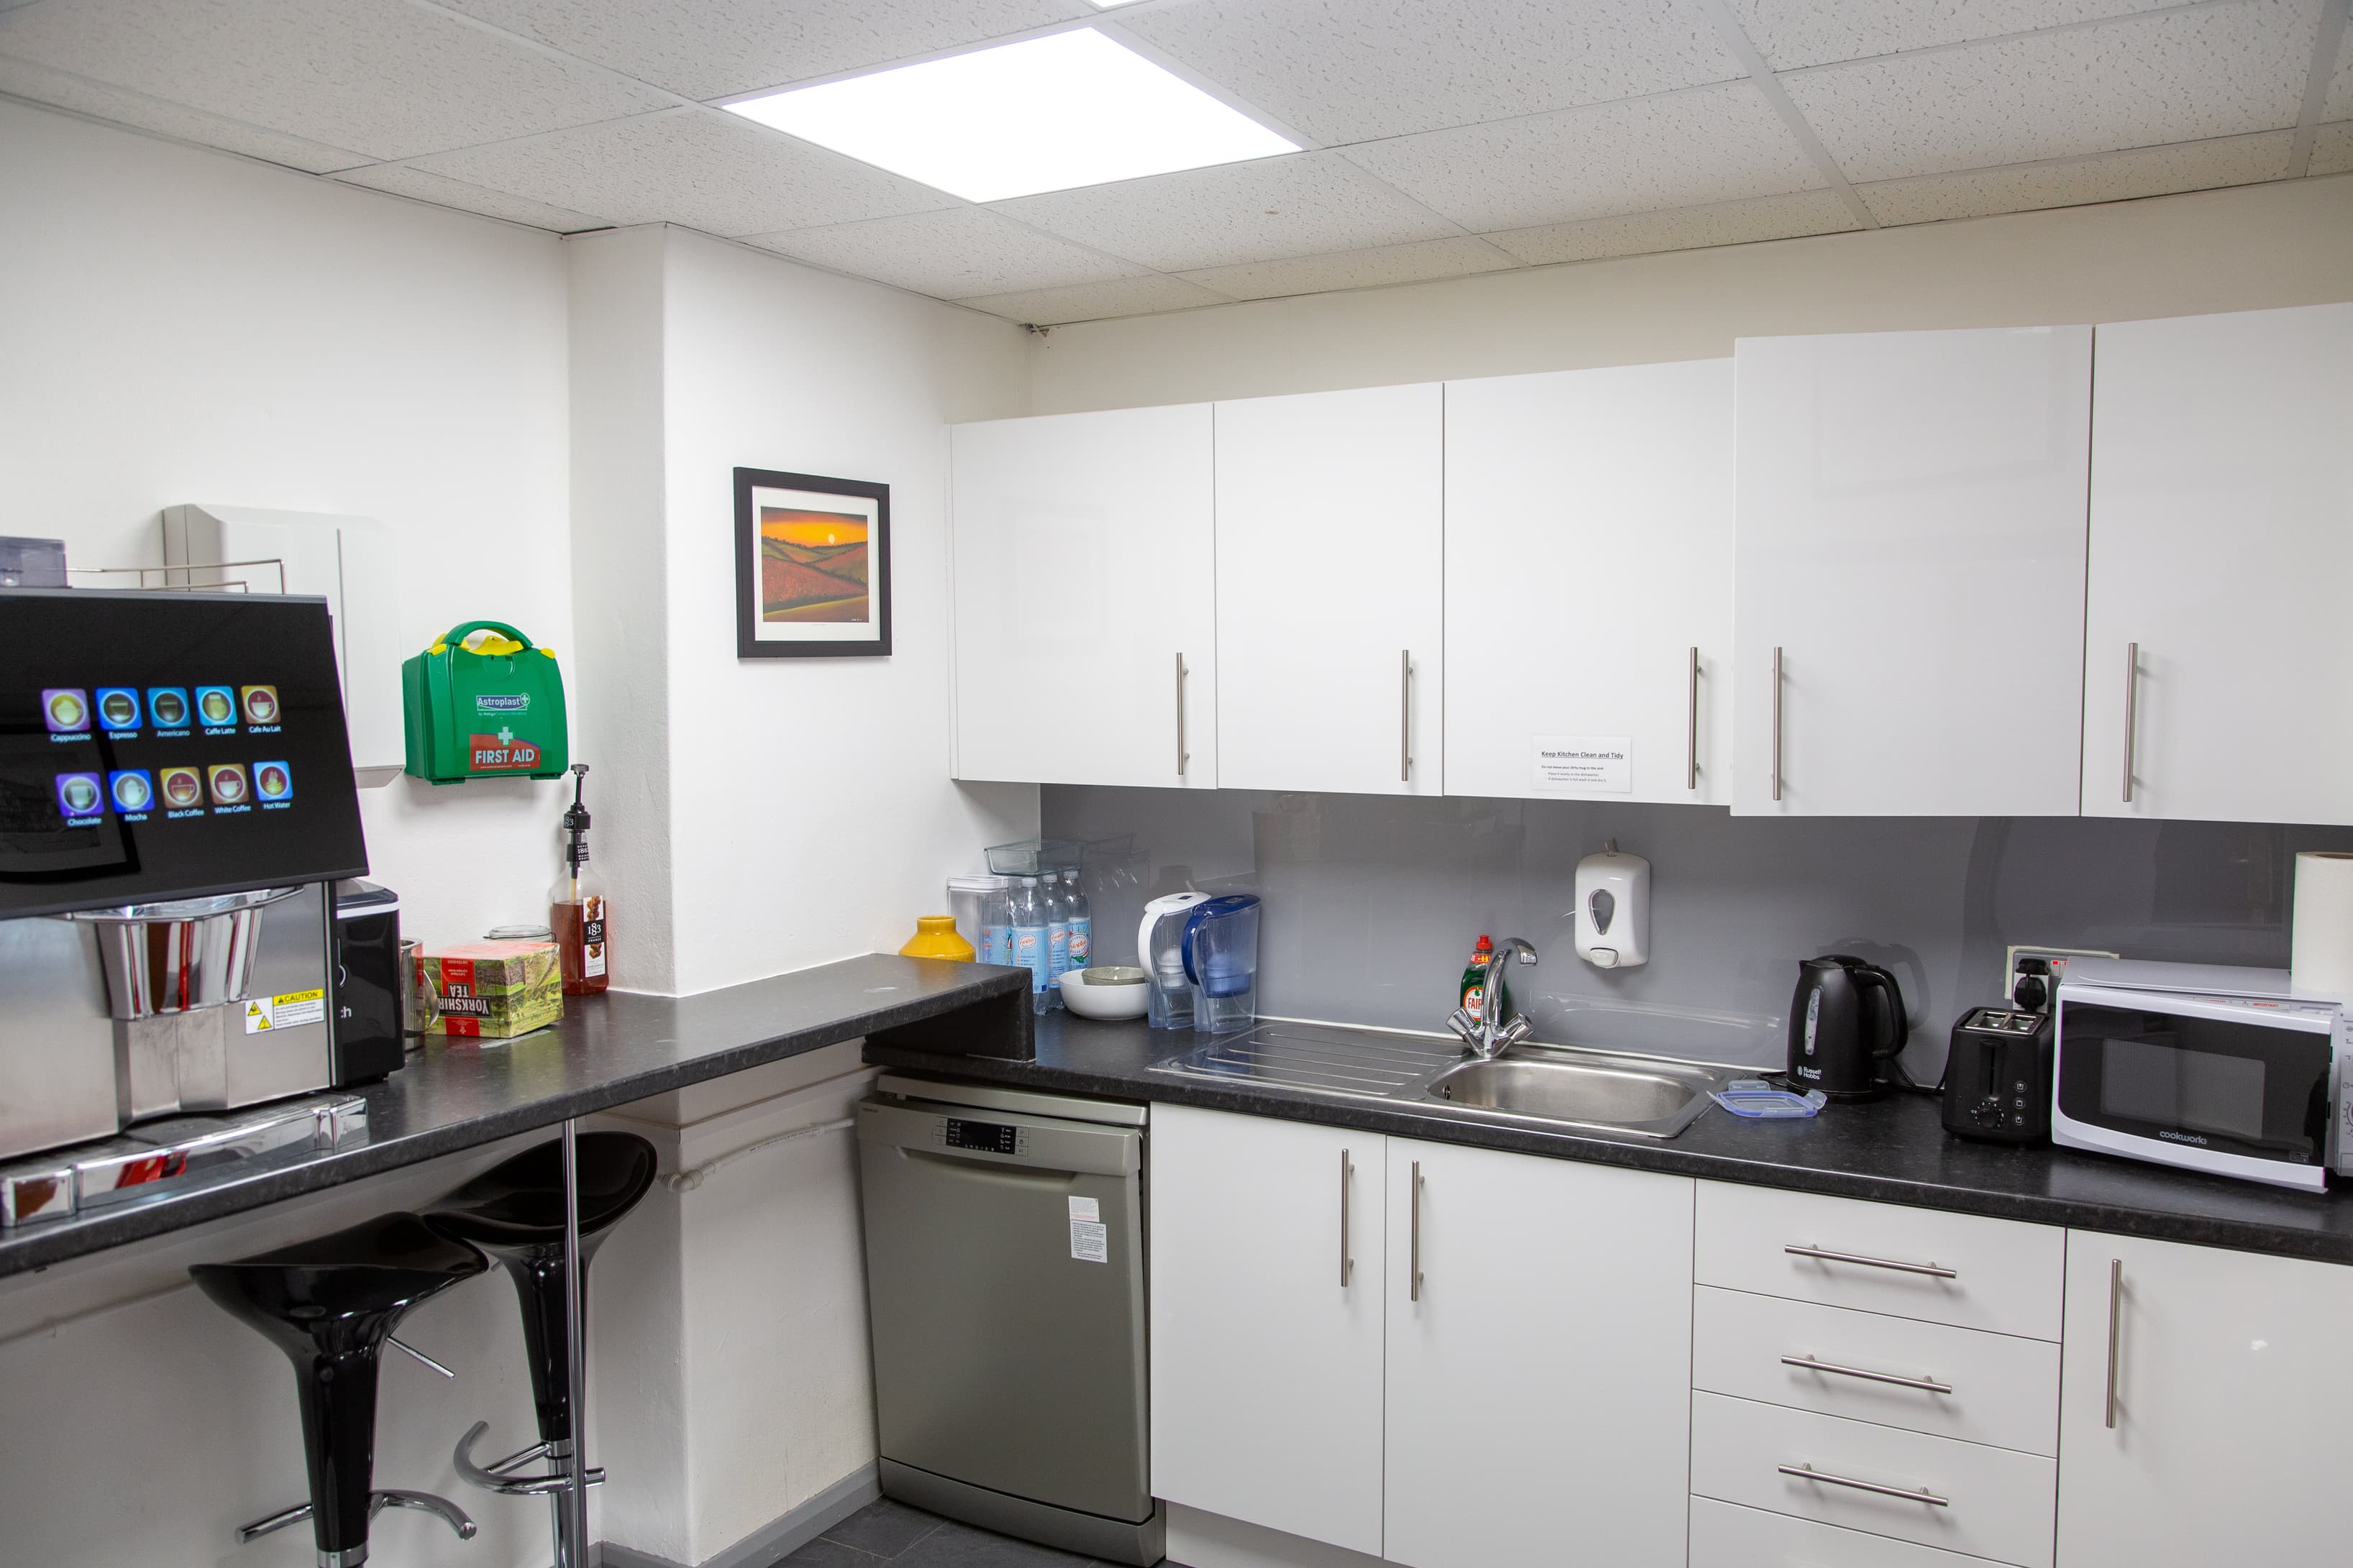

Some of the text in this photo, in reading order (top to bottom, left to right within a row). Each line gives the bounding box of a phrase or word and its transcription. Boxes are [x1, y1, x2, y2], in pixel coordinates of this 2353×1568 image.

[478, 697, 521, 707] Astroplast
[50, 733, 91, 743] Cappuccino
[109, 731, 138, 741] Espresso
[475, 748, 535, 764] FIRST AID
[168, 809, 204, 819] Black Coffee
[214, 804, 252, 815] White Coffee
[68, 817, 102, 826] Chocolate
[124, 813, 148, 822] Mocha
[449, 985, 469, 997] TEA
[284, 991, 318, 1002] CAUTION
[438, 997, 489, 1014] YORKSHIR
[1468, 997, 1481, 1009] FAIR
[1803, 1066, 1822, 1075] Russell
[1803, 1071, 1820, 1080] Hobbs
[2160, 1131, 2208, 1145] cookworks
